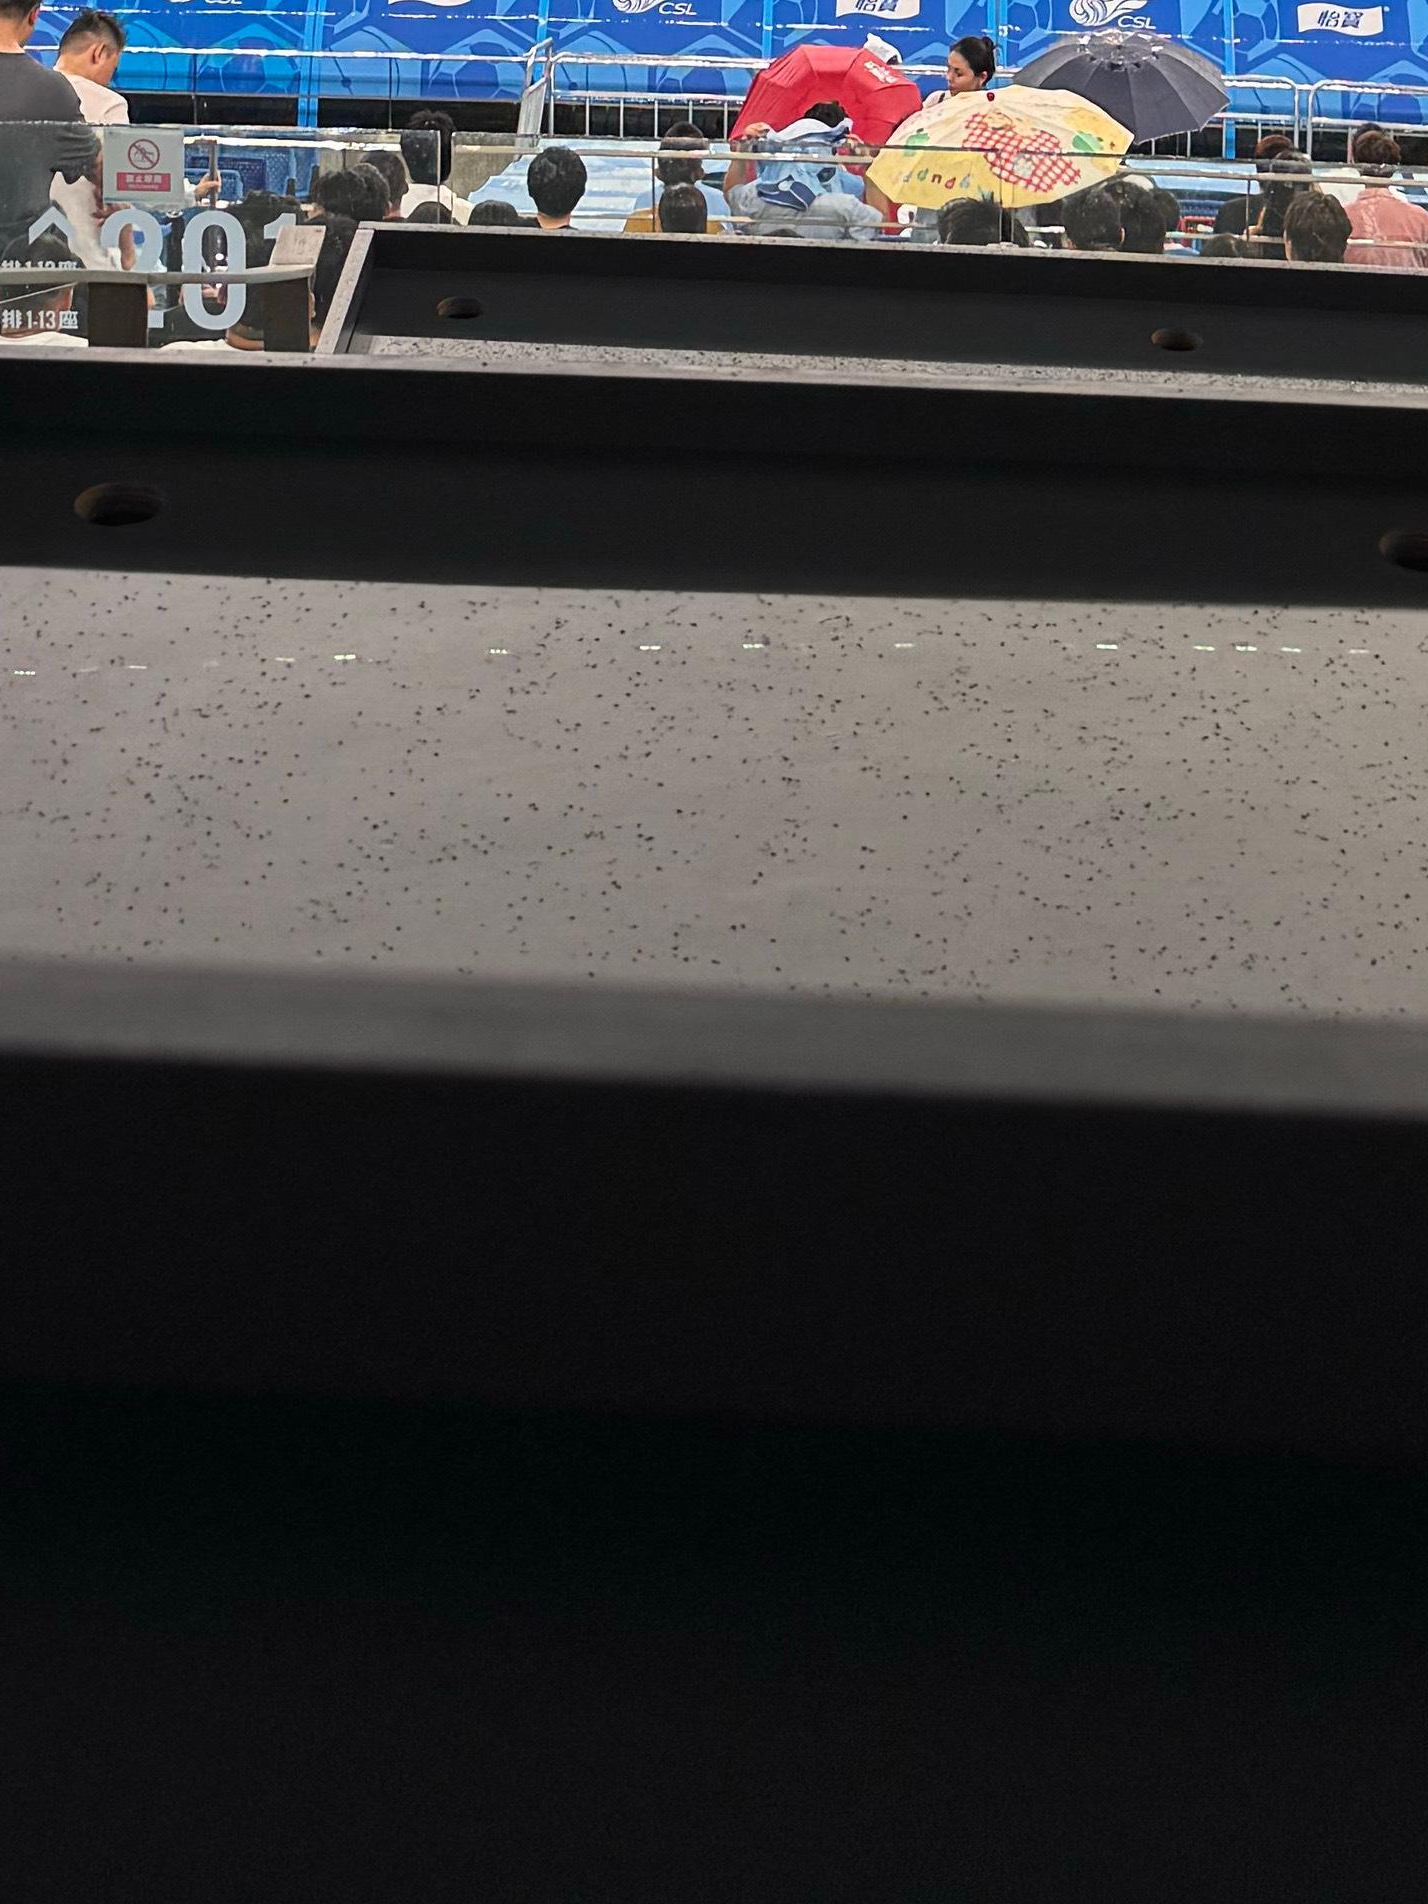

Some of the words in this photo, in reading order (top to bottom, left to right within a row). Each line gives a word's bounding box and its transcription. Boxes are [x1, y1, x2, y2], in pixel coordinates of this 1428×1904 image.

[657, 1, 698, 16] CSL
[1117, 15, 1157, 30] CSL
[100, 209, 298, 331] 20
